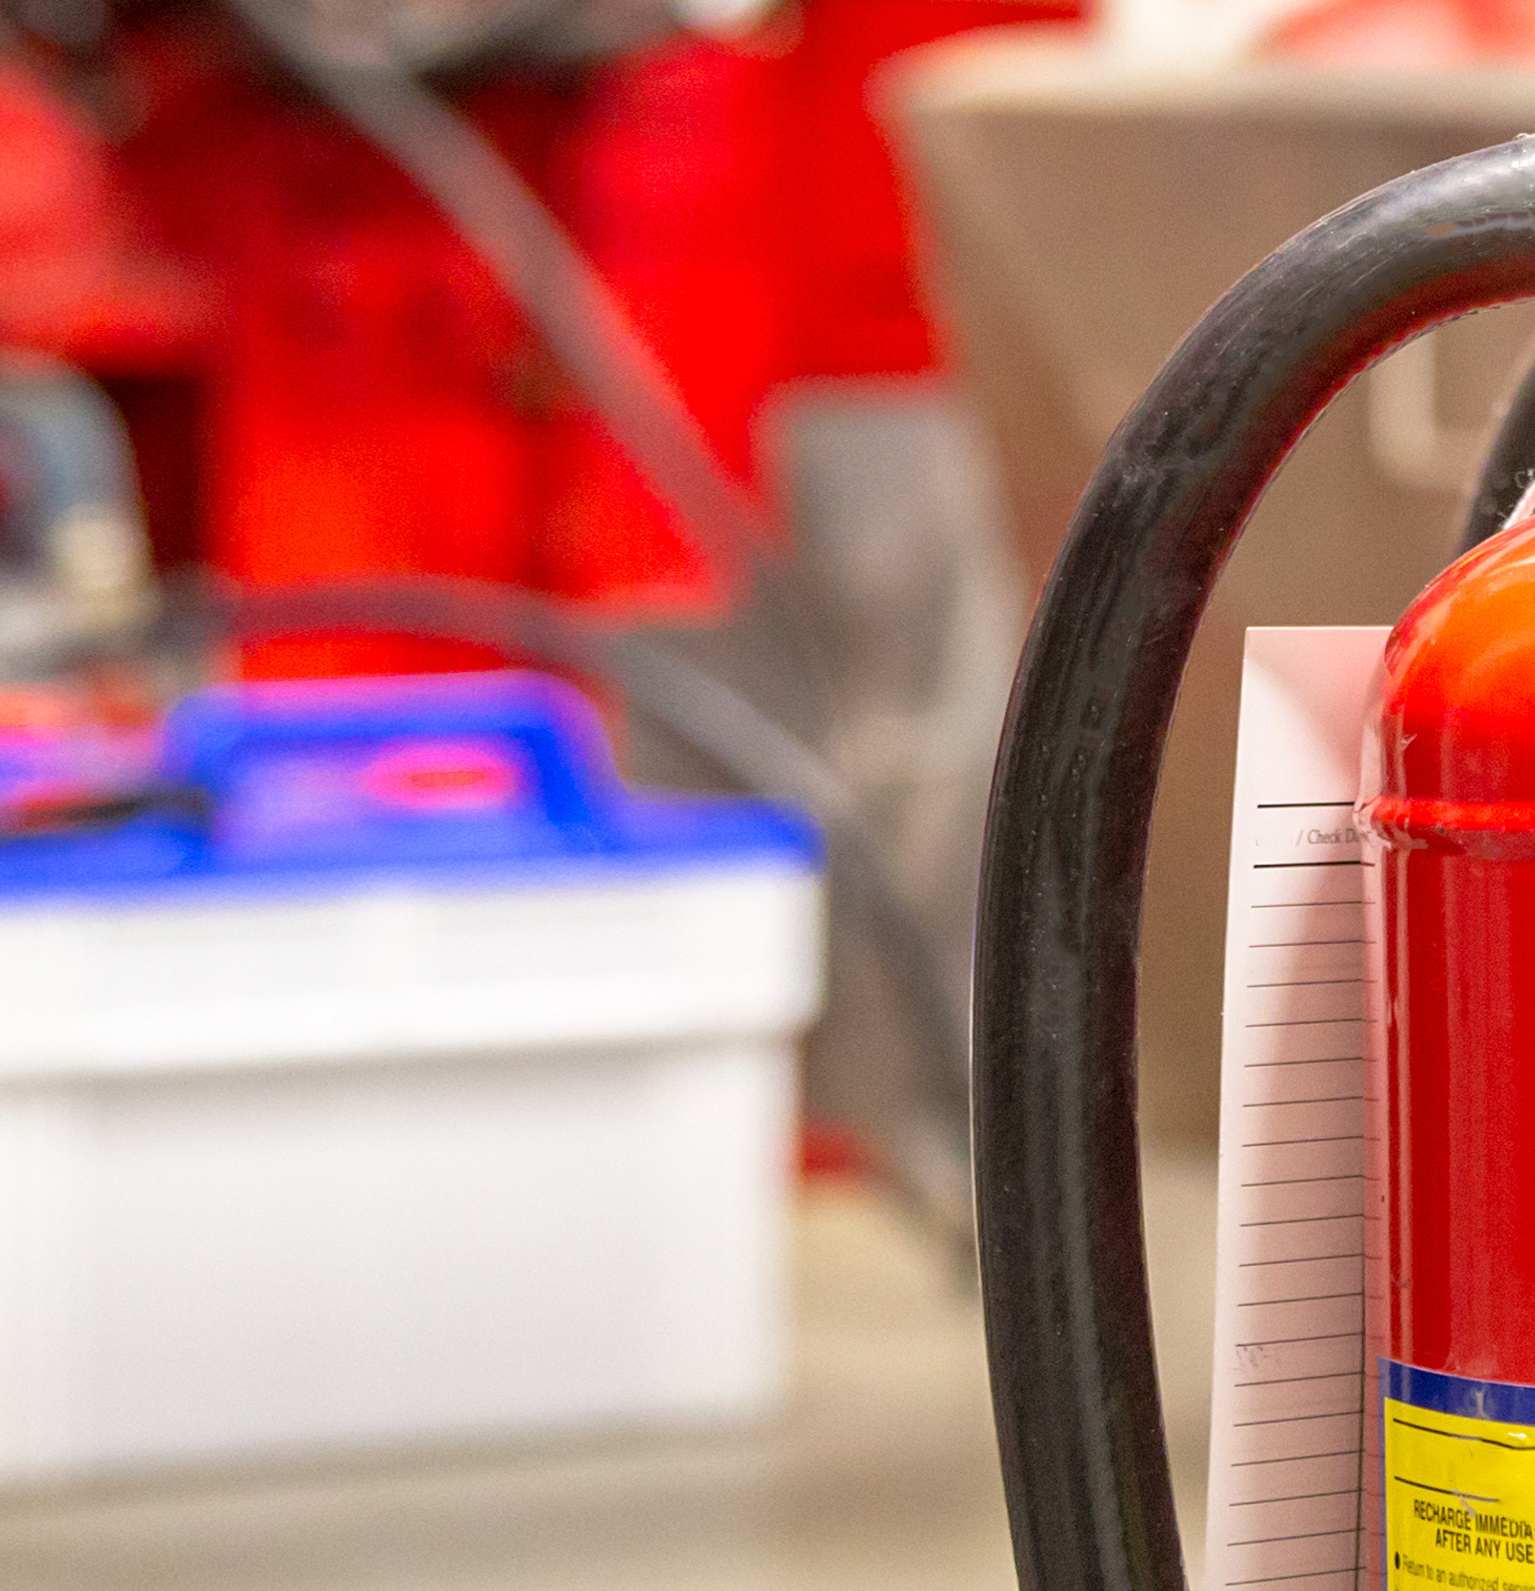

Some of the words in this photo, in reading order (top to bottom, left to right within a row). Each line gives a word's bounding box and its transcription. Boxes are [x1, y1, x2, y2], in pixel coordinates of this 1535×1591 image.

[1414, 1499, 1471, 1531] RECHARGE
[1435, 1528, 1472, 1554] AFTER
[1475, 1537, 1501, 1559] ANY
[1505, 1541, 1535, 1564] USE
